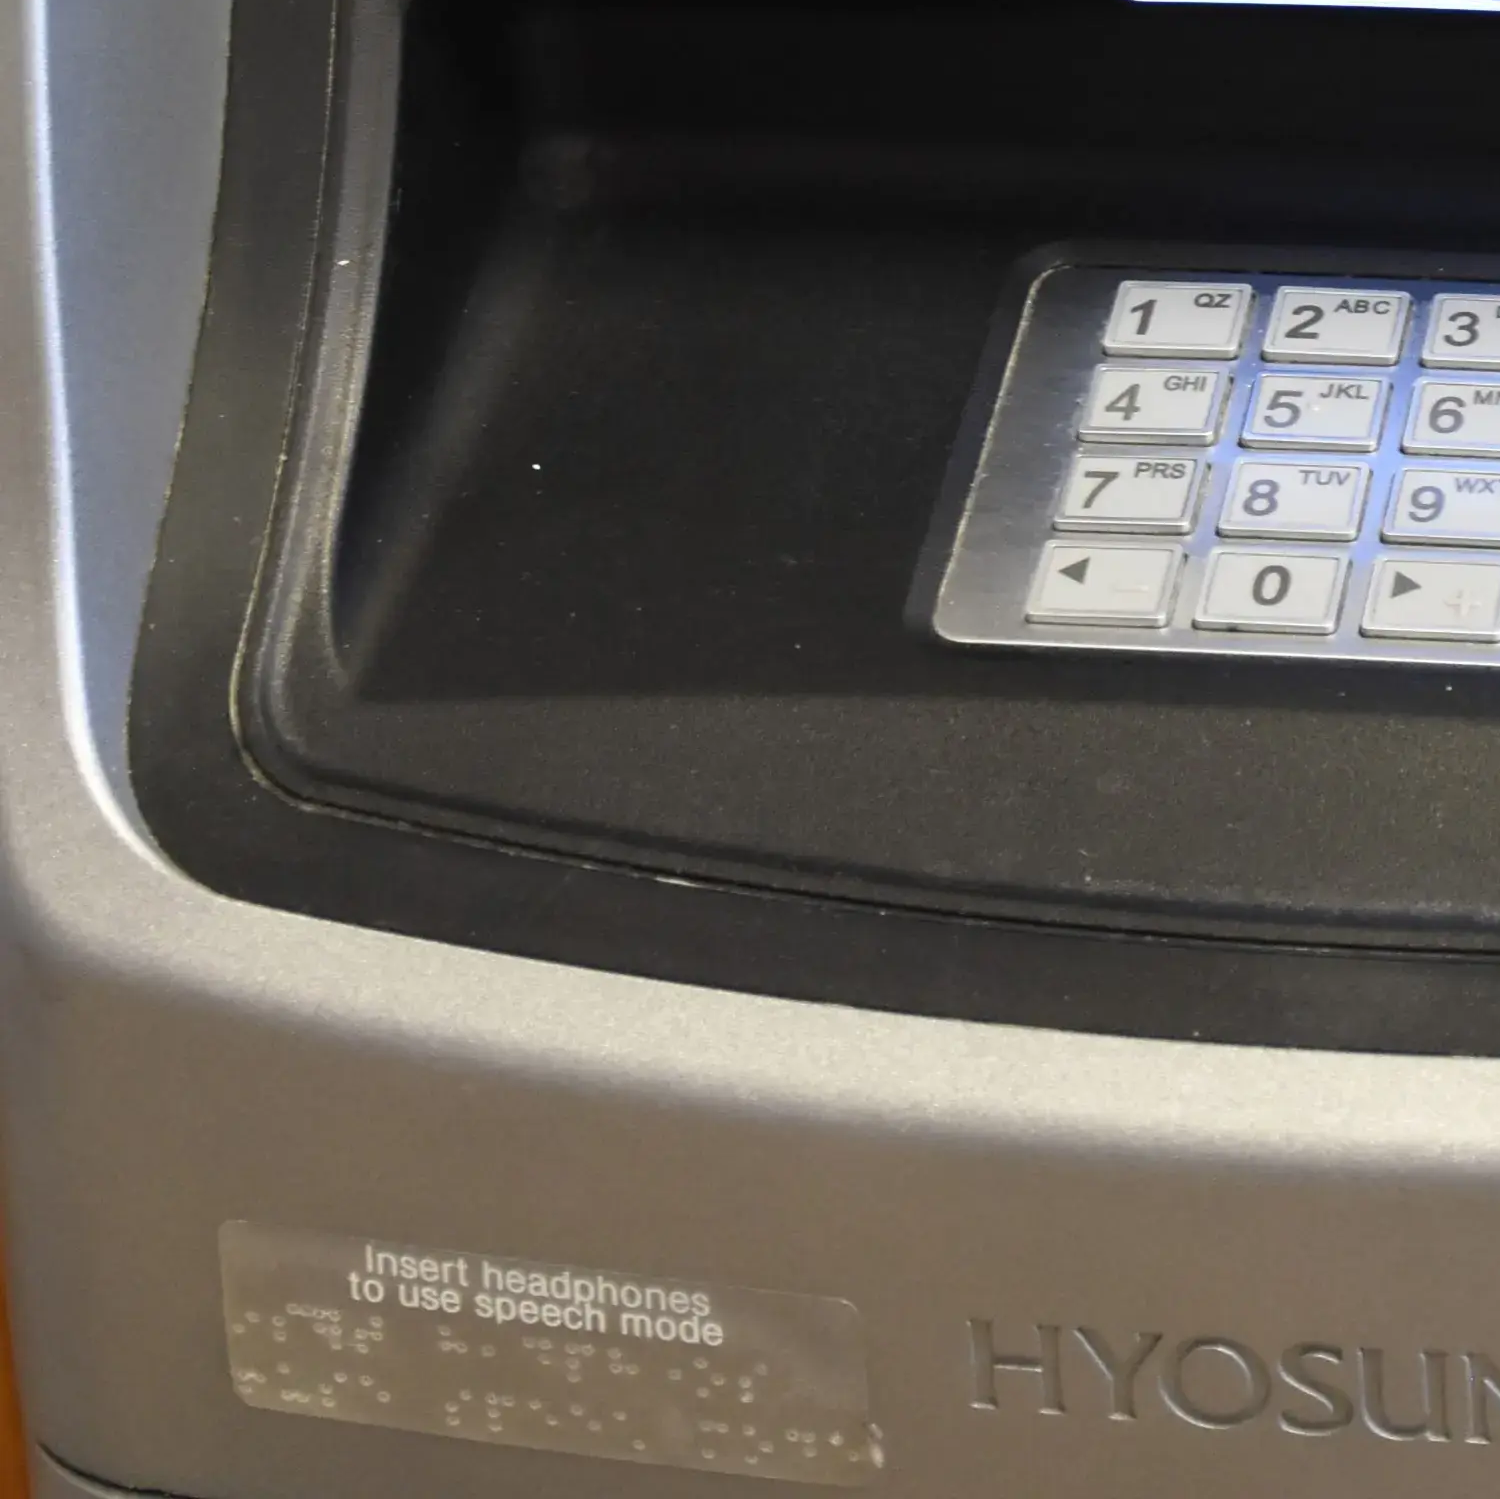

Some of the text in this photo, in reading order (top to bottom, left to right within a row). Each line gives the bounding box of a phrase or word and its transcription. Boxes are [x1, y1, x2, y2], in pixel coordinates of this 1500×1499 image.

[1130, 292, 1232, 336] 1 QZ
[1284, 299, 1391, 340] 2 ABC
[1443, 311, 1480, 347] 3
[1104, 374, 1208, 421] 4 GHI
[1263, 383, 1370, 428] 5 JKL
[1428, 396, 1466, 434] 6
[1082, 462, 1187, 509] 7 PRS
[1242, 469, 1351, 516] 8 TUV
[1408, 486, 1446, 523] 9
[1252, 565, 1292, 606] 0
[364, 1243, 712, 1318] Insert headphones
[347, 1271, 724, 1347] to use speech mode
